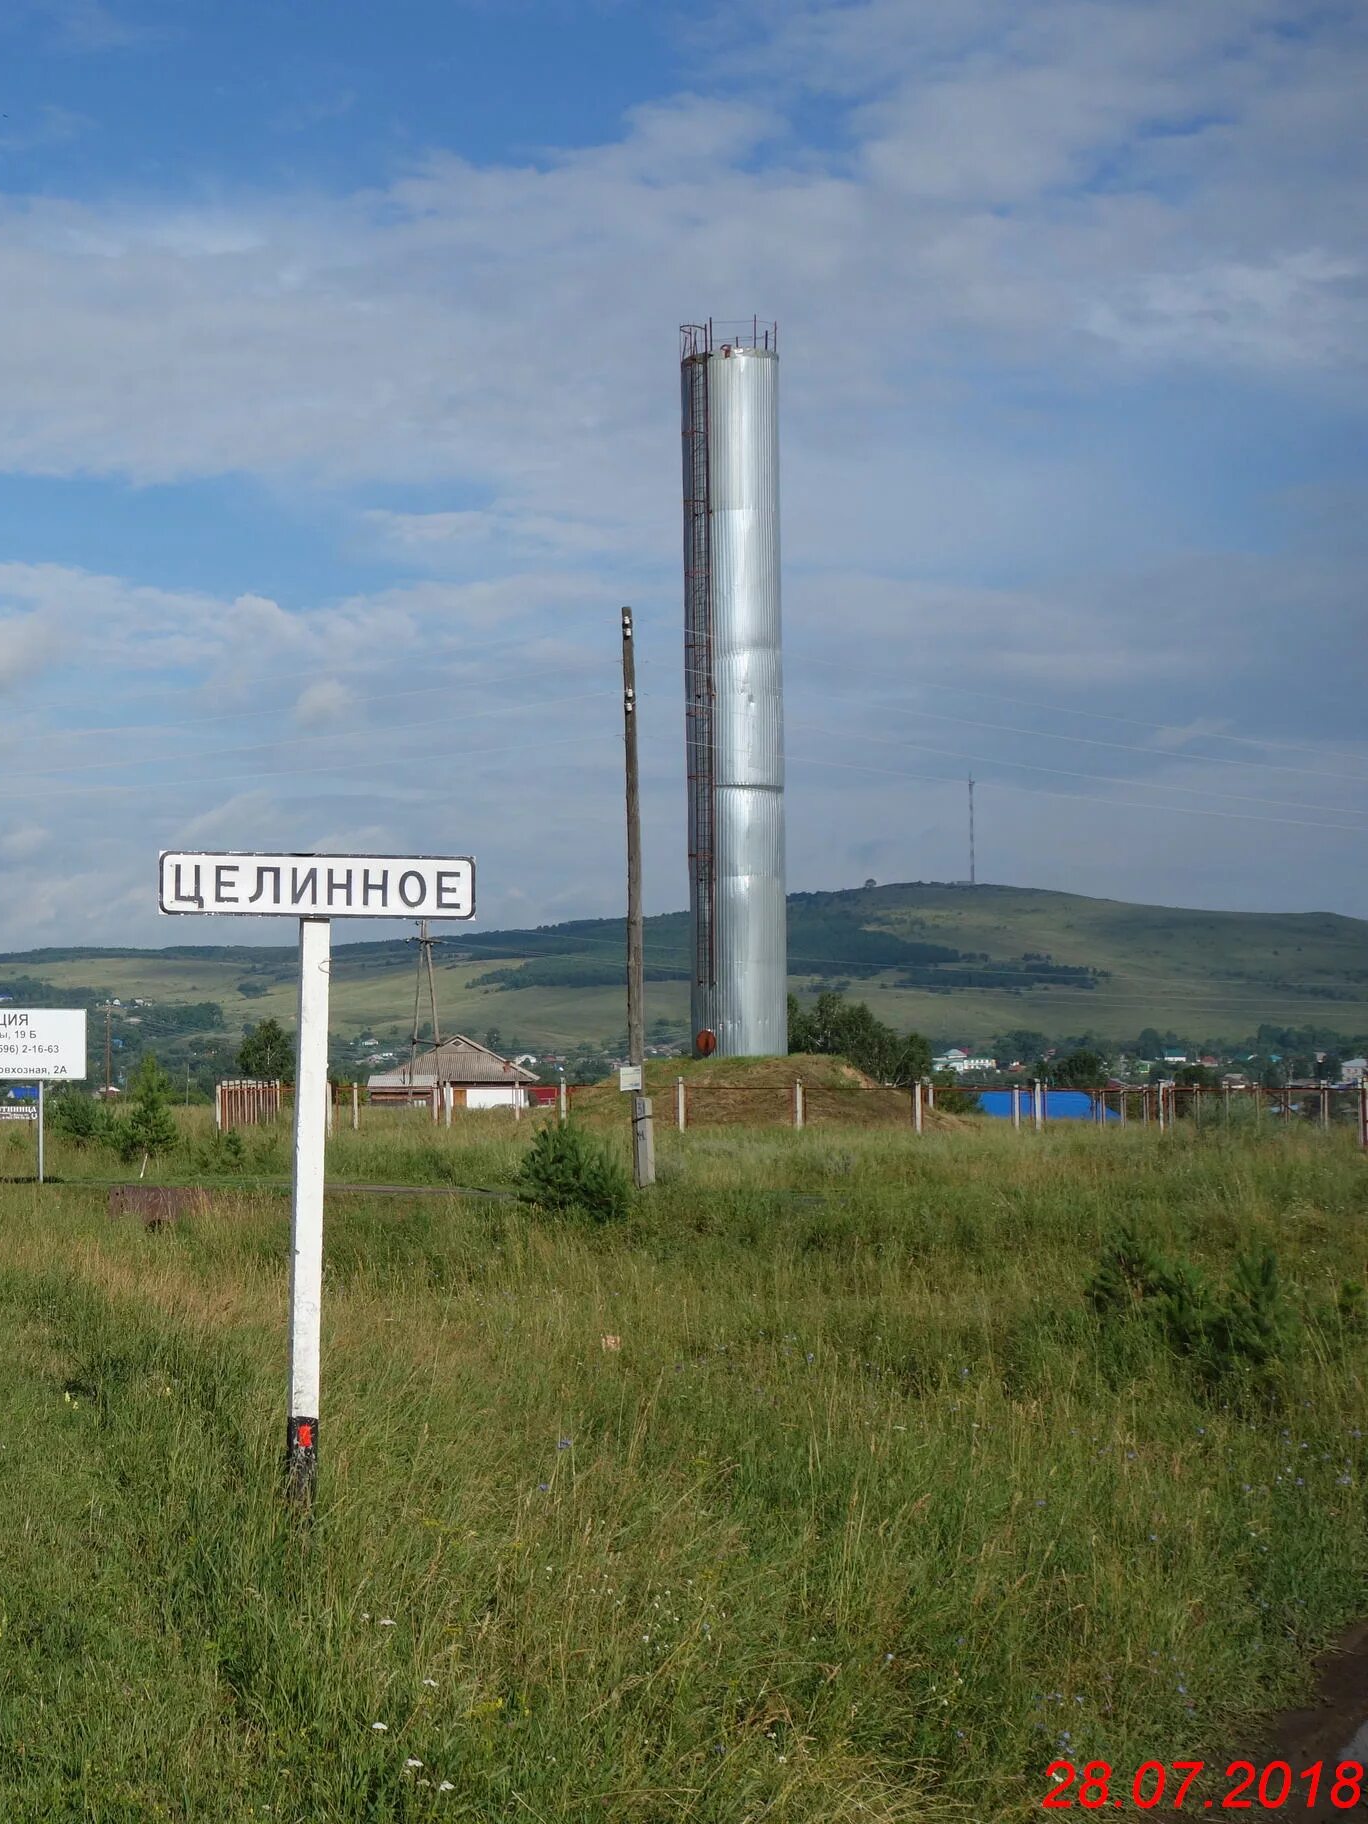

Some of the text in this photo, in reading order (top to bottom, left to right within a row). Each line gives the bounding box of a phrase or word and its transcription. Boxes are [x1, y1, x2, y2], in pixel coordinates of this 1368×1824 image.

[173, 863, 461, 909] ЦЕЛИННОЕ
[15, 1030, 26, 1039] 19
[30, 1030, 37, 1039] Б
[22, 1044, 59, 1053] 2-16-63
[54, 1066, 67, 1074] 2А
